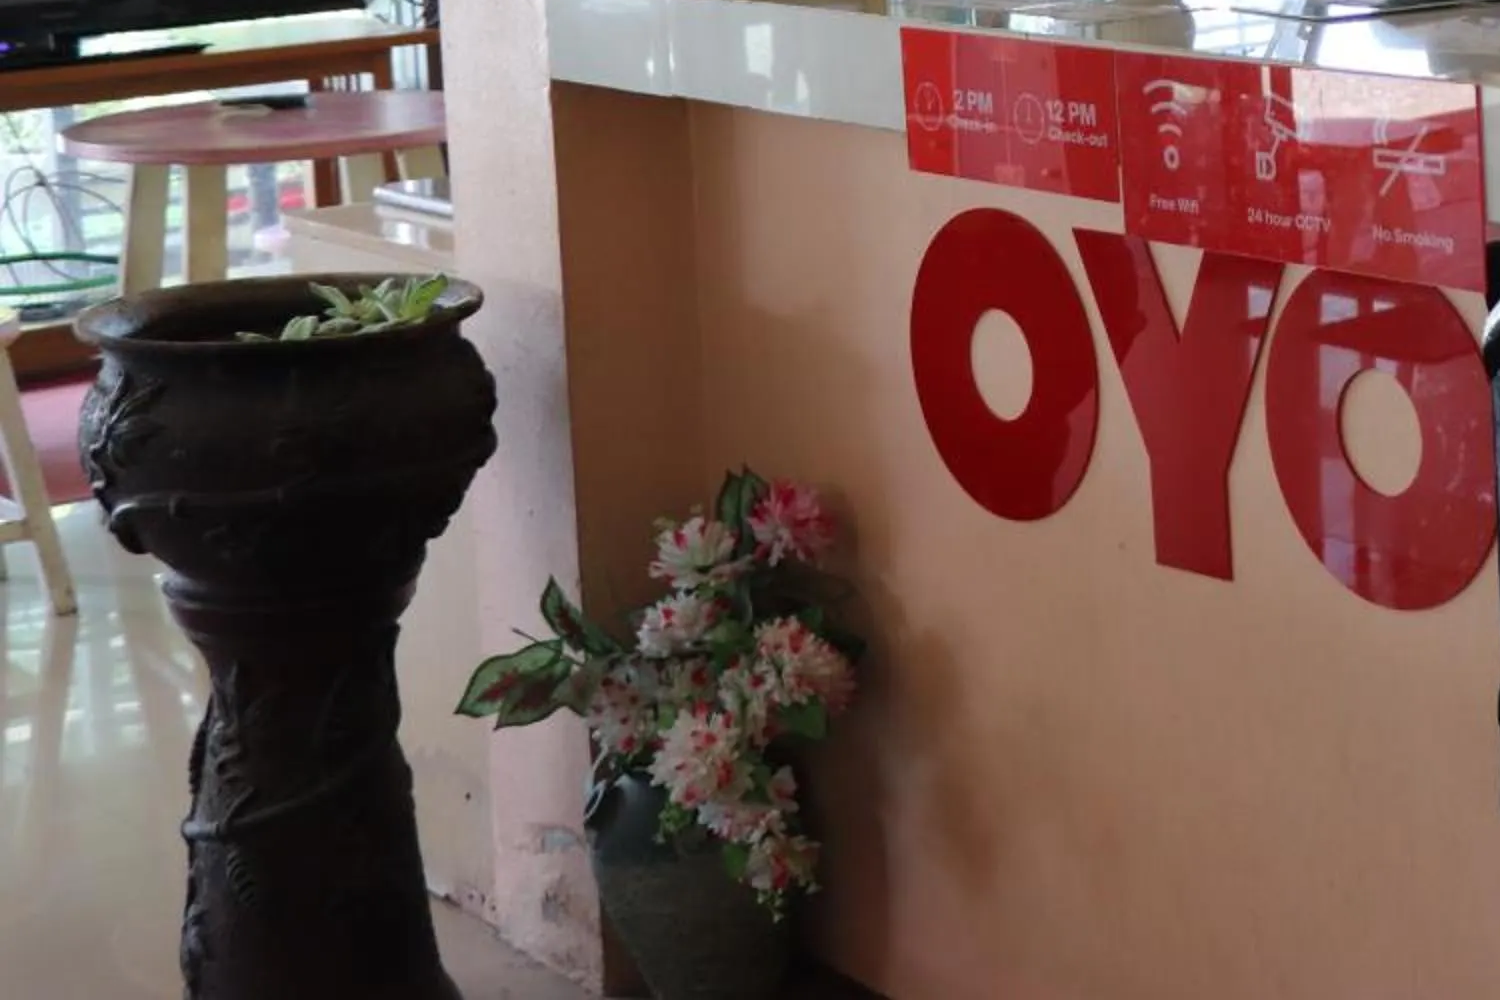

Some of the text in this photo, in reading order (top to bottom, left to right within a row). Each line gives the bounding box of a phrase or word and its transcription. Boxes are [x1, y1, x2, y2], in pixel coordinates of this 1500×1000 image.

[953, 89, 993, 113] 2 PM
[1046, 100, 1096, 126] 12 PM
[1048, 127, 1108, 147] Check-out
[1149, 194, 1177, 211] Free
[1248, 207, 1331, 232] 24 hour CCTV
[1372, 224, 1454, 255] No Smoking
[910, 208, 1500, 611] OYO
